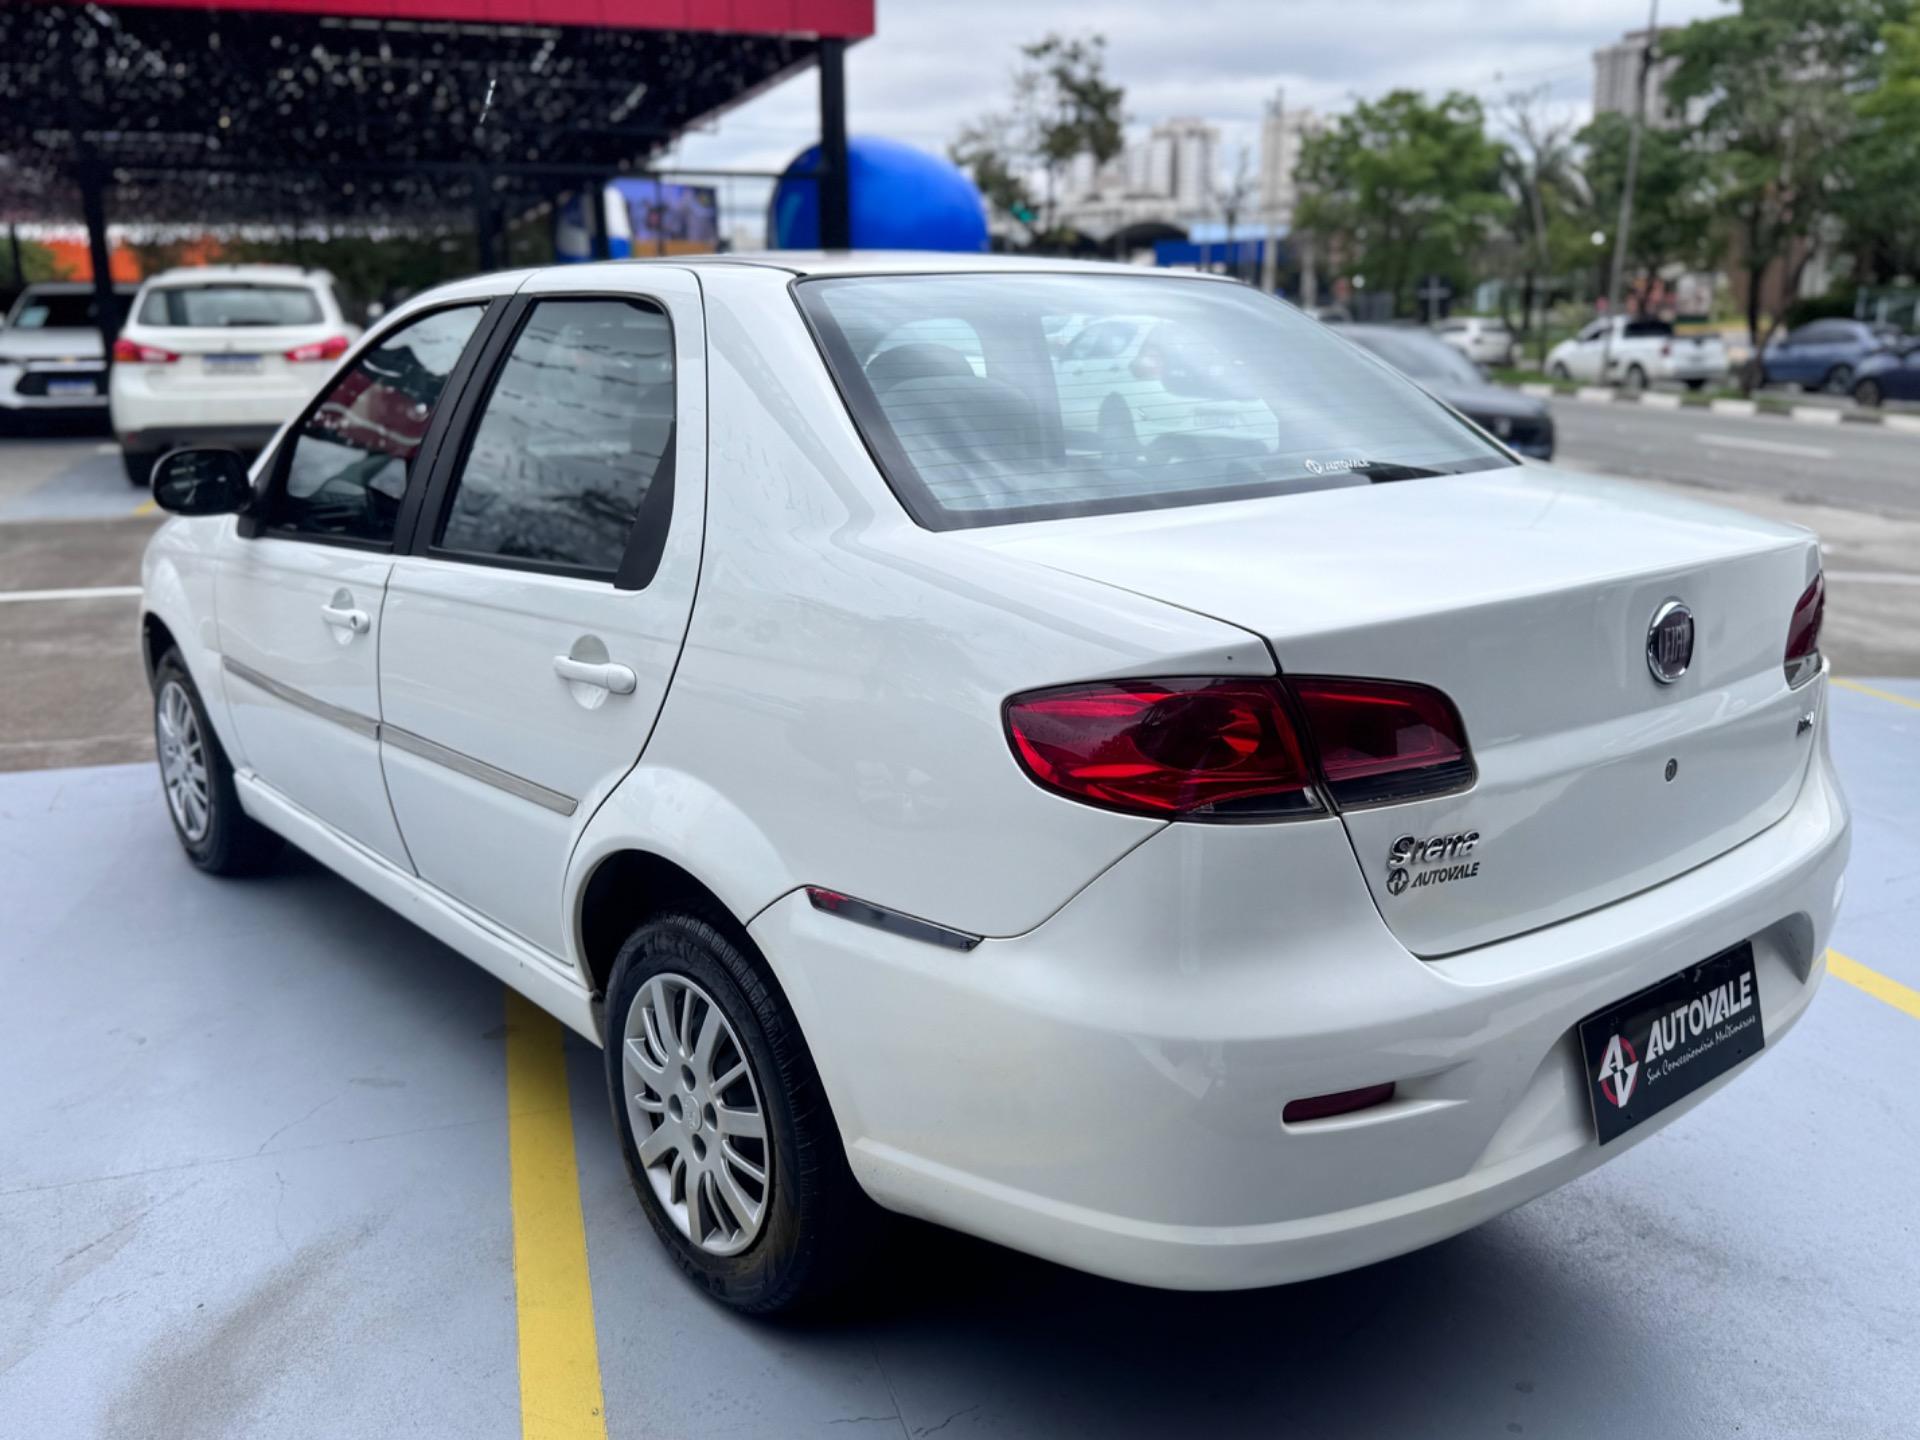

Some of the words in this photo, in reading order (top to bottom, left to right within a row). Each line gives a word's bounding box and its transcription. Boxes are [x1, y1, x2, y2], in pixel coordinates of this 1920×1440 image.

[1411, 862, 1480, 888] AUTOVALE
[1645, 971, 1752, 1064] AUTOVALE
[1646, 1067, 1662, 1085] Sua
